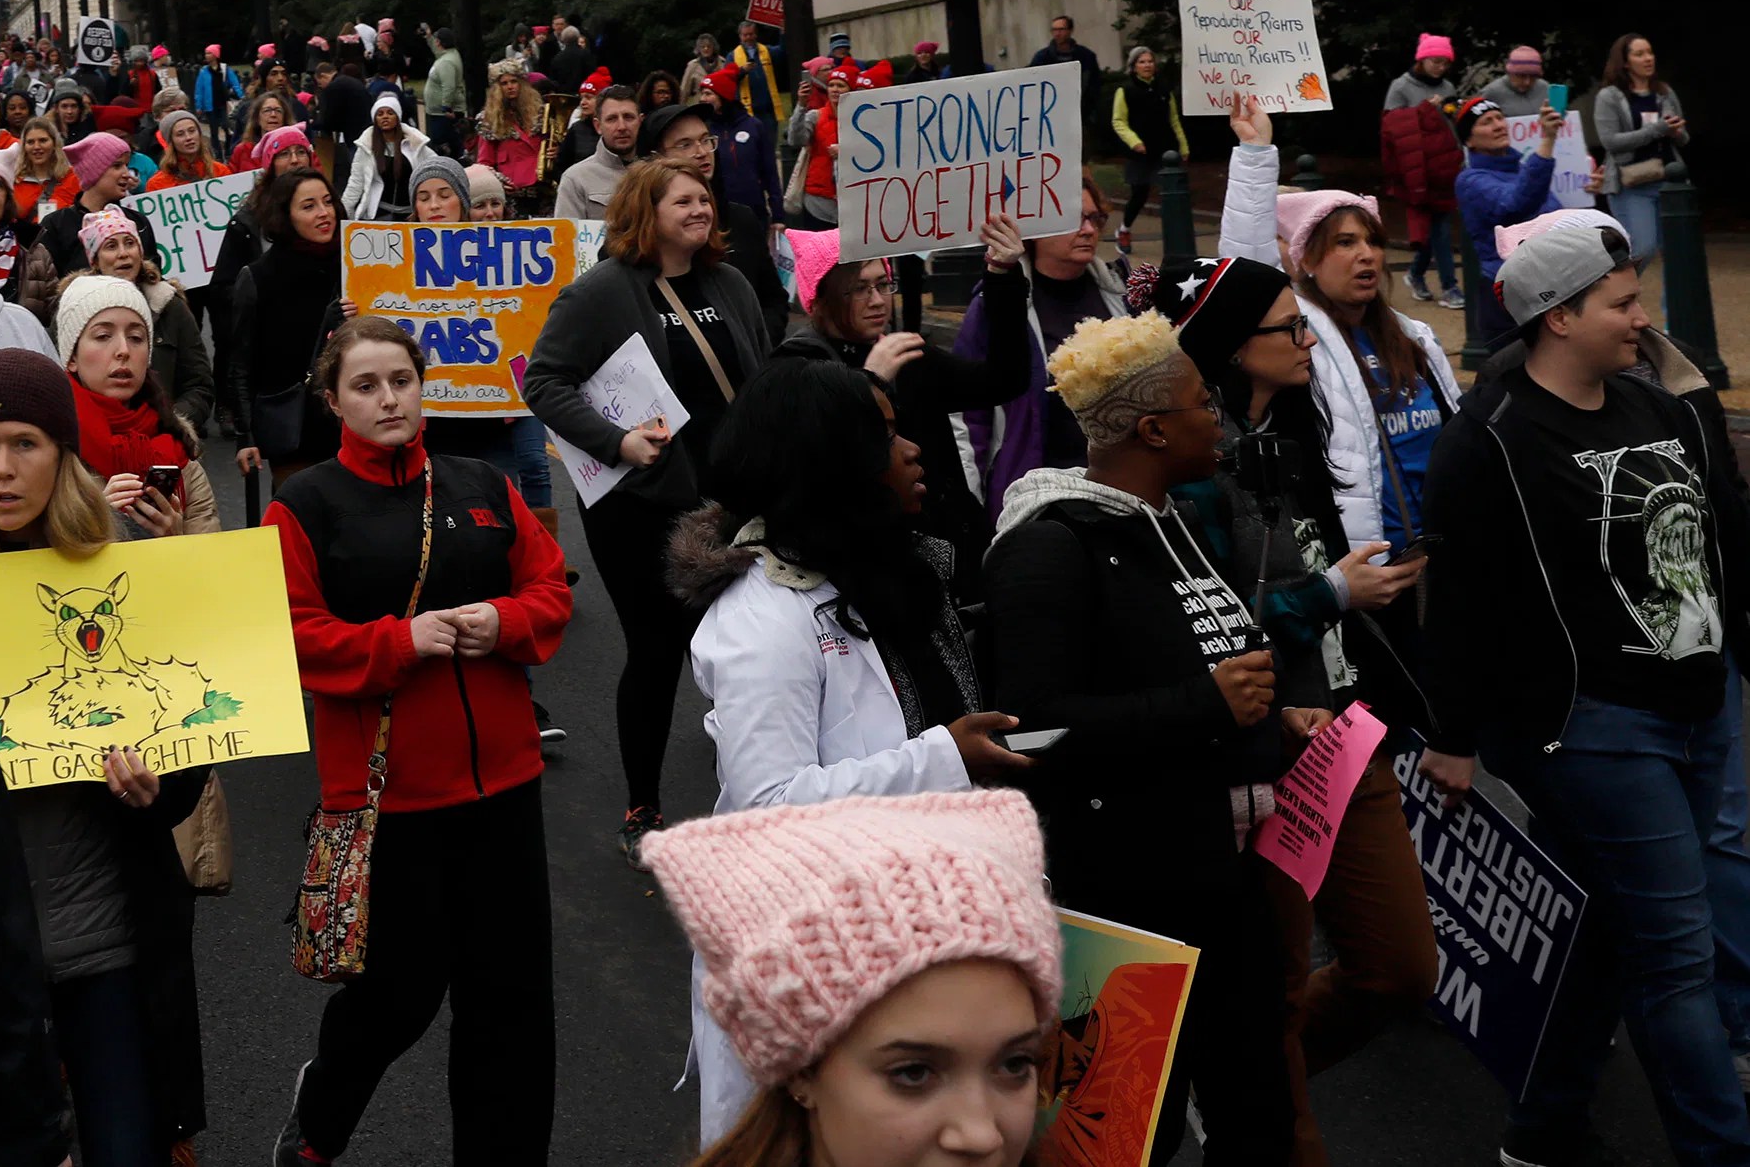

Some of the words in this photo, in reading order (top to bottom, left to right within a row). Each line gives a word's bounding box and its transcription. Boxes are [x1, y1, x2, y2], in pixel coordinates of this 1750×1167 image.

[1187, 6, 1254, 31] Reproductive
[1254, 11, 1304, 34] RIGHTS
[1198, 44, 1245, 66] Human
[1246, 45, 1296, 65] RIGHTS
[1233, 31, 1264, 45] OUR
[1199, 67, 1225, 85] We
[1230, 68, 1257, 86] Are
[1206, 83, 1295, 112] Wacing!
[852, 81, 1057, 172] STRONGER
[136, 184, 207, 227] Plant
[845, 153, 1062, 245] TOGETHER
[350, 232, 404, 262] OUR
[413, 226, 554, 287] RIGHTS
[374, 297, 413, 311] are
[417, 297, 453, 312] not
[456, 300, 477, 315] up
[480, 297, 519, 314] for
[396, 317, 499, 365] ABS
[475, 387, 506, 399] are
[604, 360, 636, 394] RIGHTS
[602, 395, 631, 421] RE:
[4, 757, 38, 786] N'T
[53, 737, 197, 779] GASGHT
[207, 730, 253, 760] ME
[1274, 801, 1298, 826] UMAN
[1297, 819, 1322, 848] RIGHTS
[1300, 799, 1325, 828] RIGHTS
[1449, 800, 1574, 931] JUSTICE
[1410, 810, 1553, 985] LIBERTY
